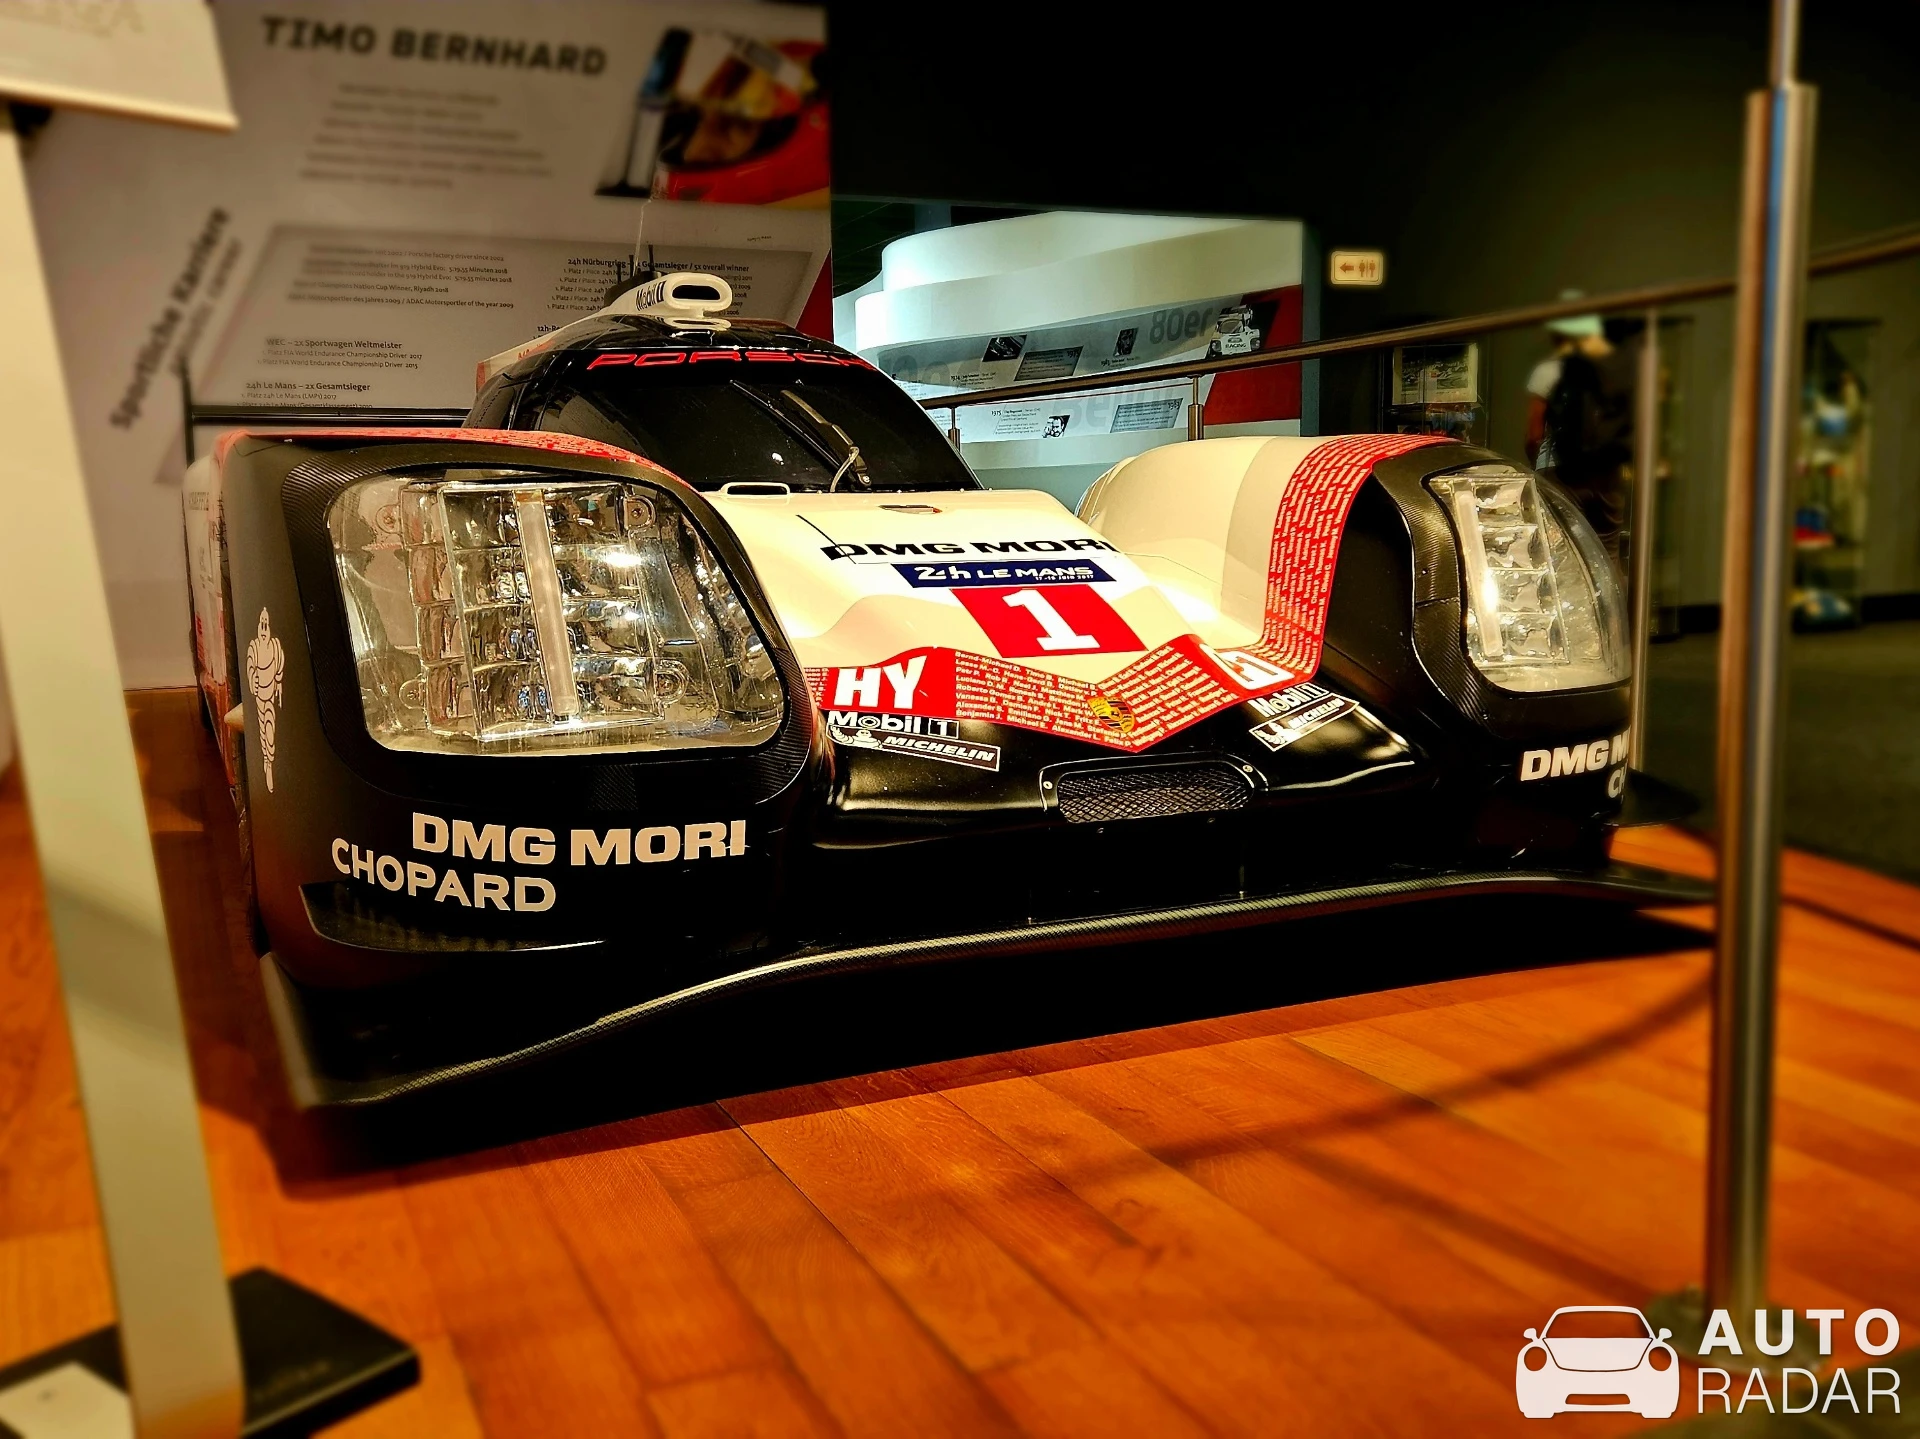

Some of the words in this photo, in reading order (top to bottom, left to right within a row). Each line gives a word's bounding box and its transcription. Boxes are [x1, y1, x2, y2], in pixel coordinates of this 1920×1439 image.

[262, 15, 376, 58] TIMO
[392, 27, 606, 77] BERNHARD
[169, 206, 231, 303] Karriere
[432, 252, 455, 260] factory
[568, 258, 582, 267] 24h
[642, 260, 688, 271] Geamtsieger
[703, 262, 727, 271] overall
[727, 264, 750, 272] winner
[411, 264, 432, 272] Hybrid
[417, 273, 439, 281] Hybrid
[425, 299, 467, 307] Motorsportler
[636, 283, 657, 312] Mobil
[1149, 307, 1214, 345] 80er
[266, 338, 286, 346] WEC
[305, 339, 353, 349] Sportwagen
[353, 341, 403, 349] Weltmeister
[347, 351, 389, 359] Championship
[246, 381, 261, 390] 24h
[316, 383, 370, 392] Gesamtsieger
[820, 543, 965, 561] DMG
[969, 538, 1120, 554] MORI
[913, 566, 971, 581] 24h
[977, 568, 1011, 579] LE
[1013, 566, 1094, 578] MANS
[1001, 588, 1101, 651] 1
[834, 656, 928, 710] HY
[955, 676, 986, 686] Luciano
[985, 674, 1001, 682] Rob
[1040, 687, 1076, 700] Matthias
[1026, 668, 1046, 680] Timo
[1057, 676, 1090, 689] Michael
[955, 684, 989, 694] Roberto
[1063, 705, 1084, 715] Mark
[955, 692, 989, 702] Vanessa
[1045, 708, 1063, 718] Nick
[955, 701, 996, 711] Alexander
[1008, 708, 1042, 722] Emiliano
[1247, 686, 1312, 718] Mobil
[828, 711, 921, 734] Mobil
[955, 709, 996, 719] Benjamin
[1006, 715, 1039, 727] Michael
[1052, 724, 1093, 738] Alexander
[1288, 698, 1345, 730] MICHELIN
[882, 736, 995, 764] MICHELIN
[1521, 739, 1609, 781] DMG
[412, 812, 557, 866] DMG
[569, 819, 746, 867] MORI
[331, 837, 556, 912] CHOPARD
